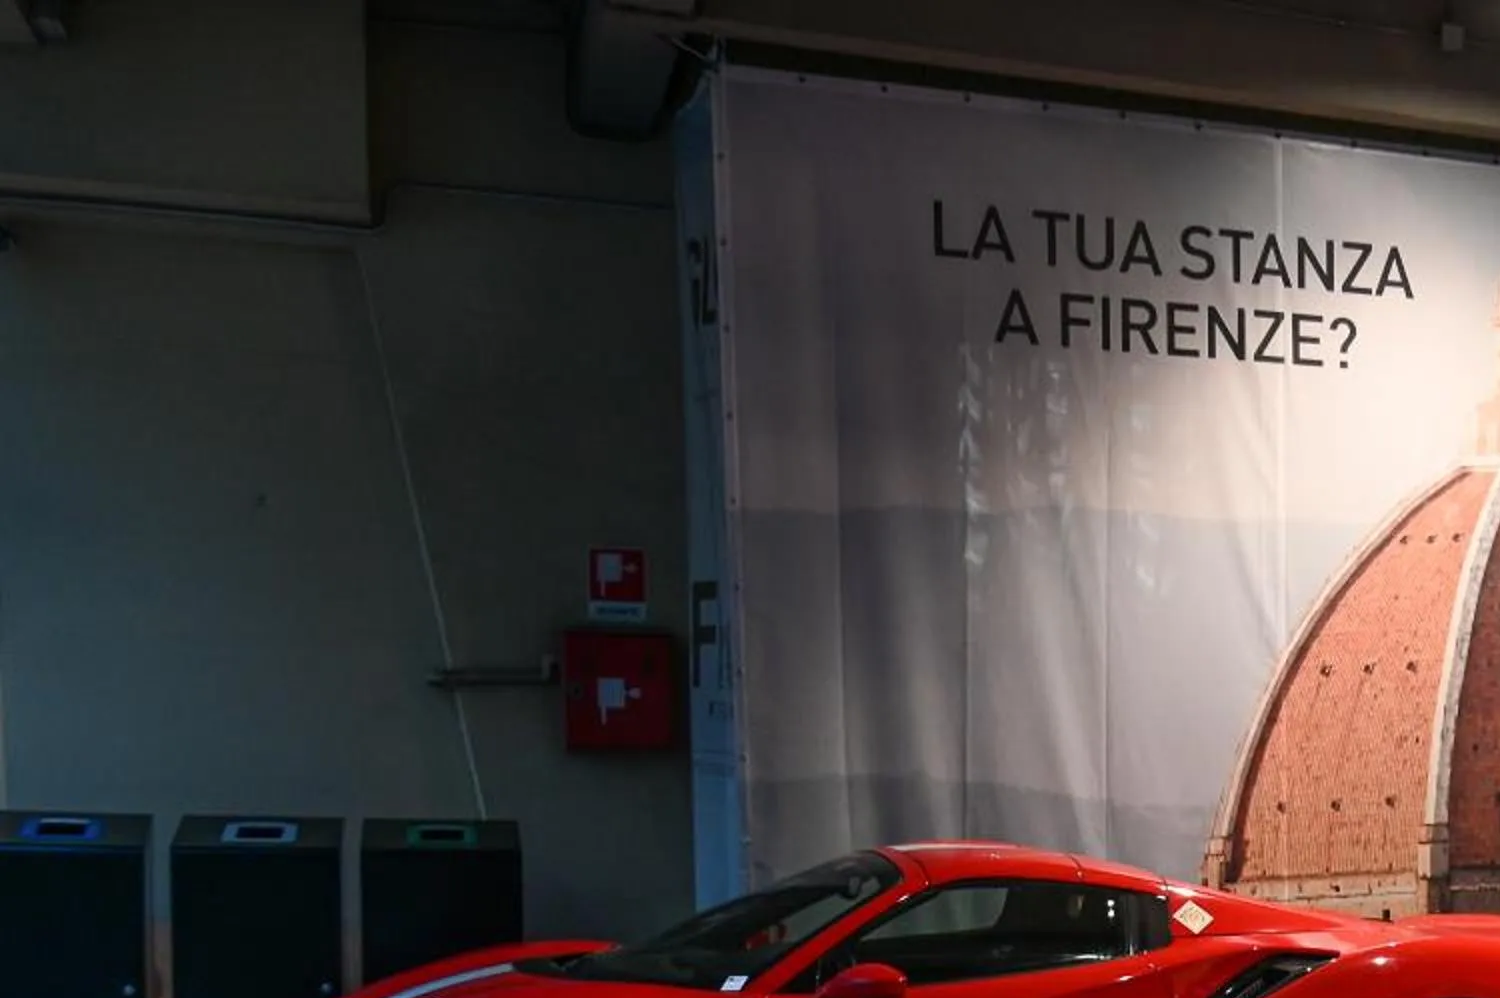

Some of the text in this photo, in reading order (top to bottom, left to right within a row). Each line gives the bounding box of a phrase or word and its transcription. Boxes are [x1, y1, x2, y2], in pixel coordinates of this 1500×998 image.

[933, 200, 1415, 299] LA TUA STANZA
[995, 290, 1357, 368] A FIRENZE?
